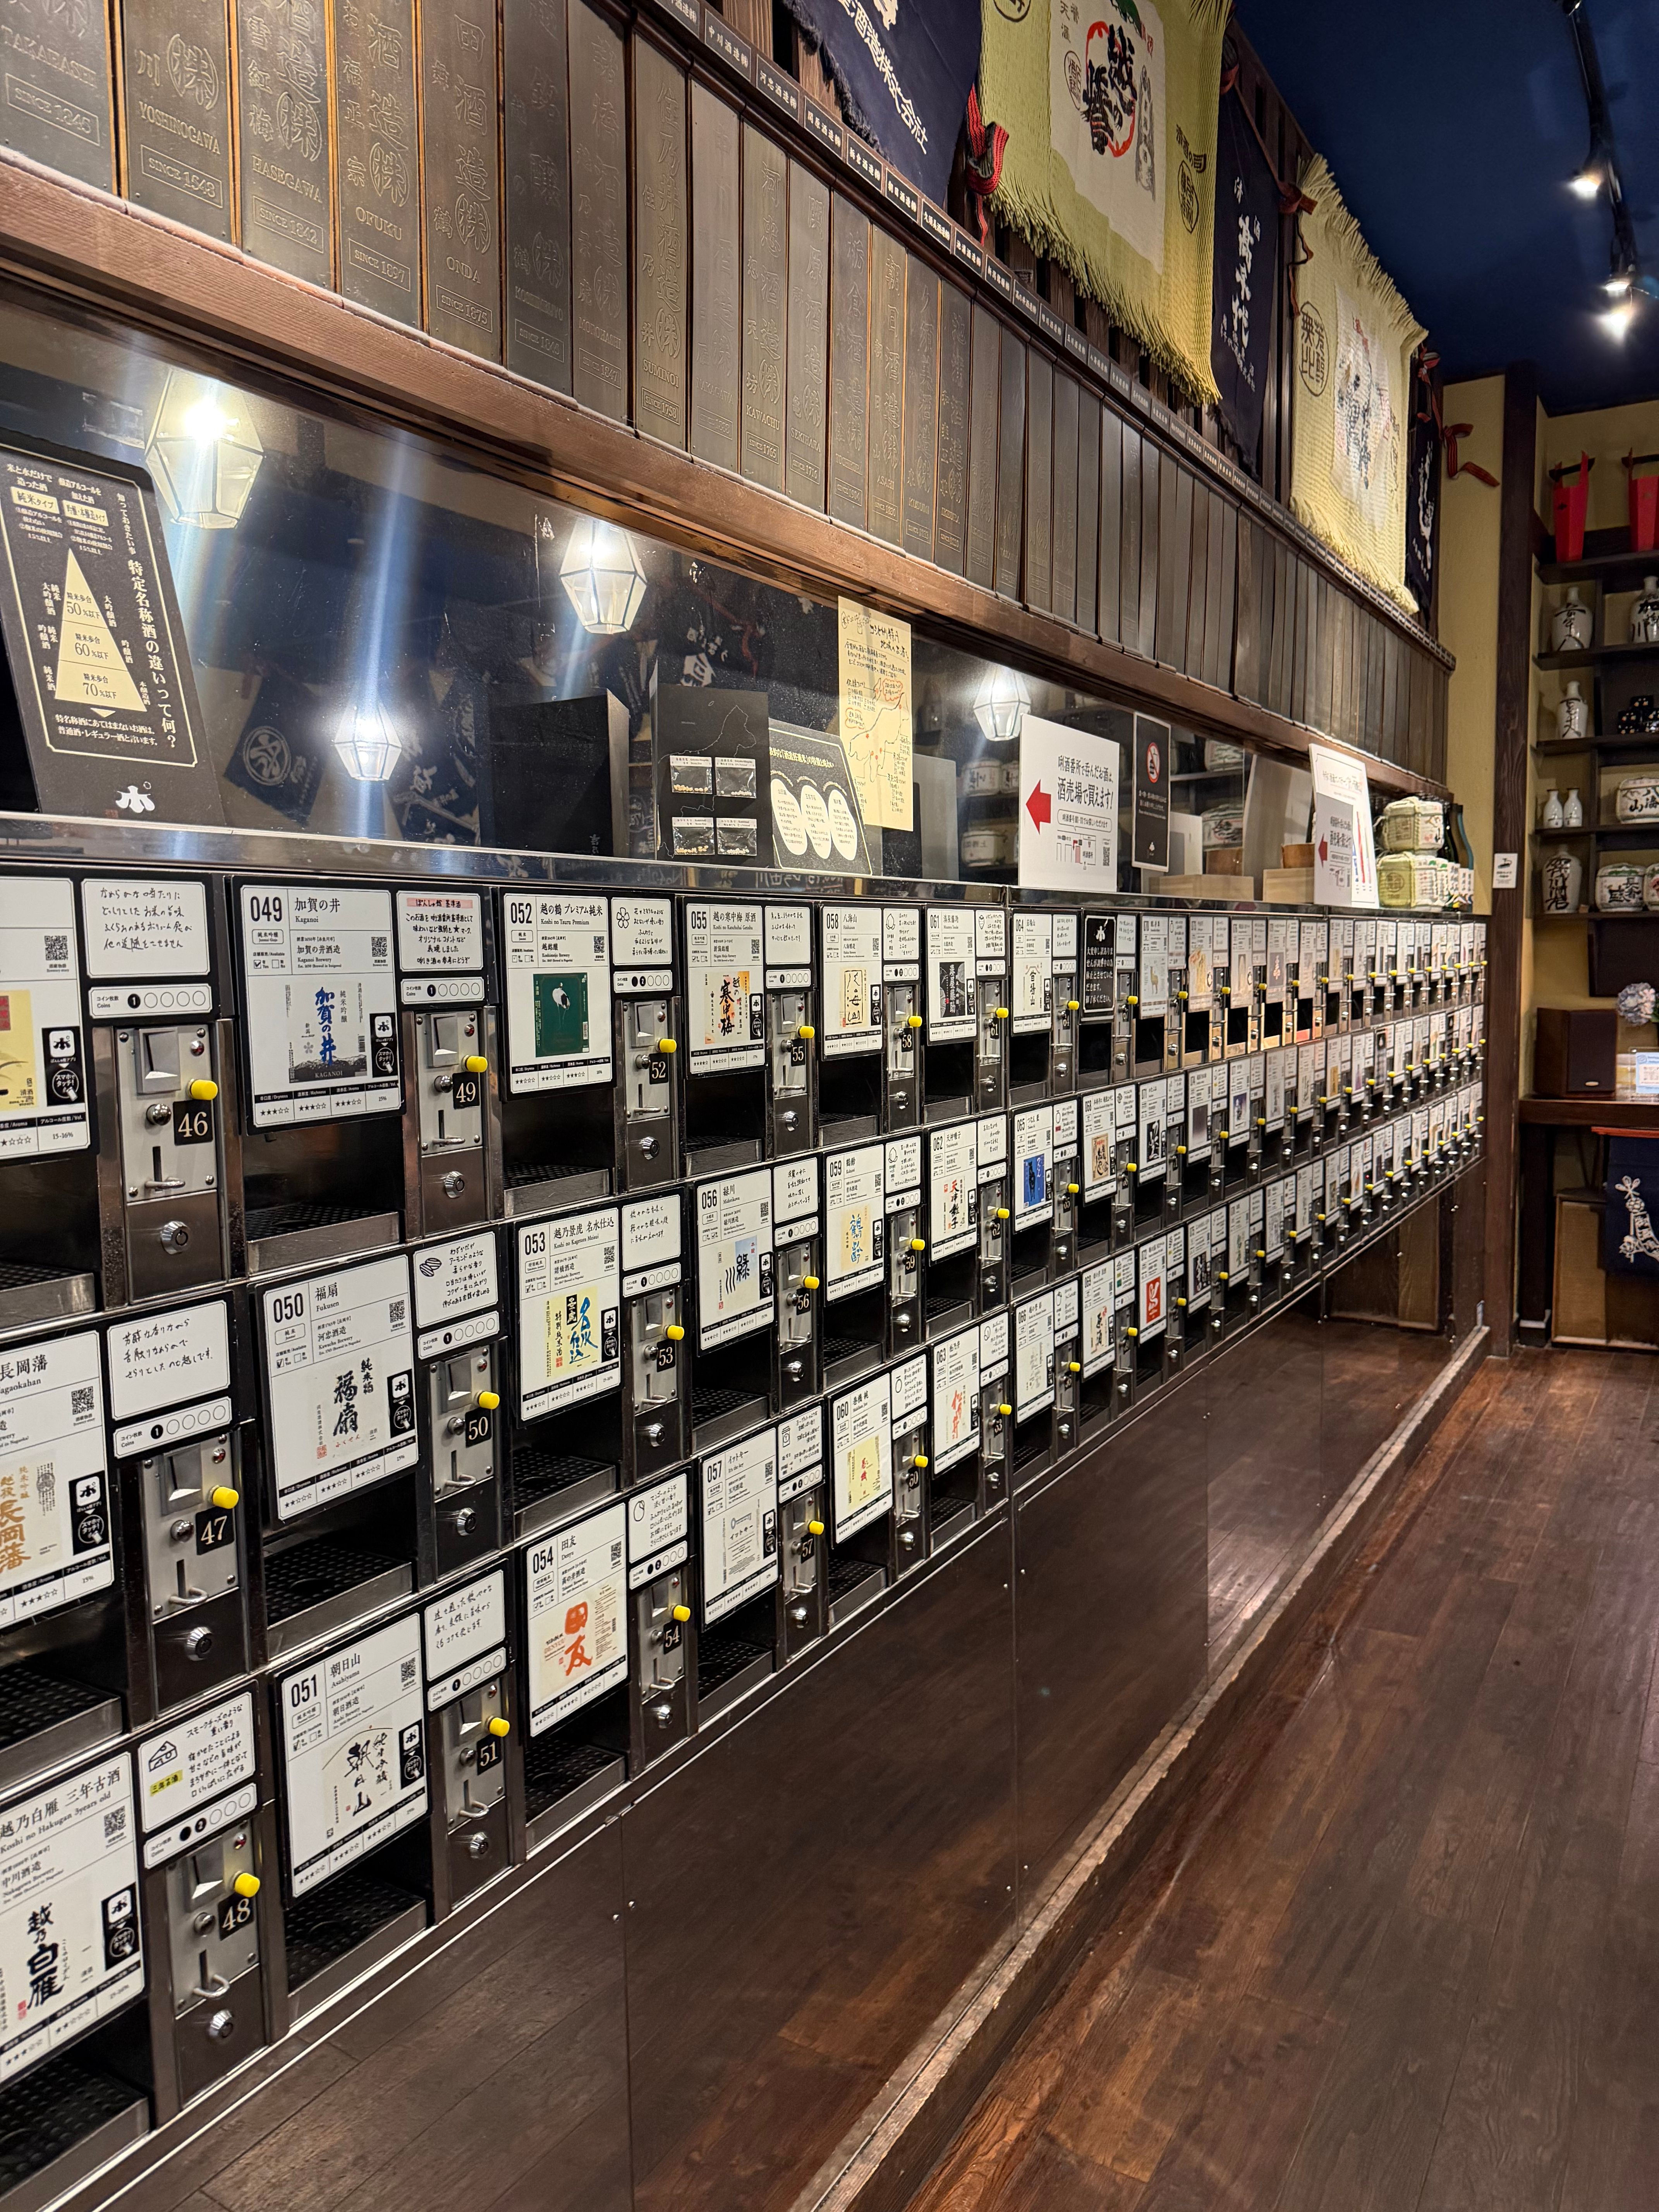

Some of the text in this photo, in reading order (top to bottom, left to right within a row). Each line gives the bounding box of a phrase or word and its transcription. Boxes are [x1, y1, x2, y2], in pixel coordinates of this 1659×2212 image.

[139, 101, 221, 155] YOSHINOGAWA
[148, 157, 181, 181] SINCE
[252, 155, 323, 204] HASEGAWA
[259, 208, 288, 228] SINCE
[356, 206, 402, 240] OFUKU
[355, 249, 405, 283] SINCE 1897
[446, 256, 481, 284] ONDA
[441, 294, 488, 325] SINCE 1875
[519, 328, 539, 344] SINCE
[643, 359, 679, 388] SUMINOI
[645, 395, 661, 411] SINCE
[745, 404, 780, 431] KAWACHU
[749, 438, 762, 451] SINCE
[790, 427, 821, 453] SEKIHARA
[877, 475, 895, 490] ASAHI
[17, 491, 54, 509] 純米タイプ
[250, 896, 283, 922] 049
[294, 896, 340, 913] 加賀の井
[510, 902, 532, 924] 052
[295, 915, 319, 924] Kaganoi
[691, 911, 707, 930] 055
[713, 912, 756, 923] 越の寒中梅 原酒
[826, 913, 839, 929] 058
[842, 914, 858, 923] 八海山
[930, 914, 940, 929] 061
[1015, 919, 1024, 932] 064
[297, 945, 341, 955] 加賀の井酒造
[340, 990, 348, 1023] 純米吟醸
[315, 986, 337, 1066] 加賀の井
[902, 1034, 912, 1048] 58
[793, 1046, 804, 1061] 55
[315, 1070, 343, 1079] KAGANOI
[652, 1061, 666, 1079] 52
[456, 1081, 477, 1104] 49
[177, 1112, 209, 1137] 46
[933, 1135, 943, 1152] 062
[830, 1160, 842, 1178] 059
[702, 1188, 717, 1210] 056
[553, 1216, 615, 1240] 越乃景虎 名水仕込
[524, 1231, 546, 1256] 053
[906, 1256, 915, 1270] 59
[314, 1282, 338, 1301] 福扇
[798, 1293, 810, 1310] 56
[273, 1293, 304, 1323] 050
[316, 1301, 339, 1312] Fukusen
[318, 1326, 347, 1342] 河忠酒造
[318, 1341, 337, 1350] Kawachu
[659, 1346, 673, 1367] 53
[936, 1348, 946, 1365] 063
[333, 1370, 358, 1437] 福扇
[836, 1400, 849, 1421] 060
[469, 1416, 489, 1441] 50
[727, 1450, 749, 1465] イットキー
[707, 1460, 723, 1484] 057
[201, 1515, 227, 1546] 47
[560, 1535, 577, 1552] 田友
[802, 1538, 814, 1557] 57
[532, 1546, 554, 1575] 054
[564, 1601, 593, 1676] 田友
[665, 1626, 680, 1647] 54
[330, 1652, 361, 1678] 朝日山
[331, 1670, 360, 1688] Asahiyama
[291, 1674, 317, 1708] 051
[333, 1696, 359, 1717] 朝日酒造
[479, 1742, 497, 1766] 51
[64, 1767, 121, 1807] 三年古酒
[0, 1836, 24, 1854] Koshi
[26, 1832, 36, 1841] no
[38, 1814, 72, 1835] Hakugan
[99, 1791, 111, 1803] old
[2, 1861, 41, 1888] 中川酒造
[221, 1897, 252, 1932] 48
